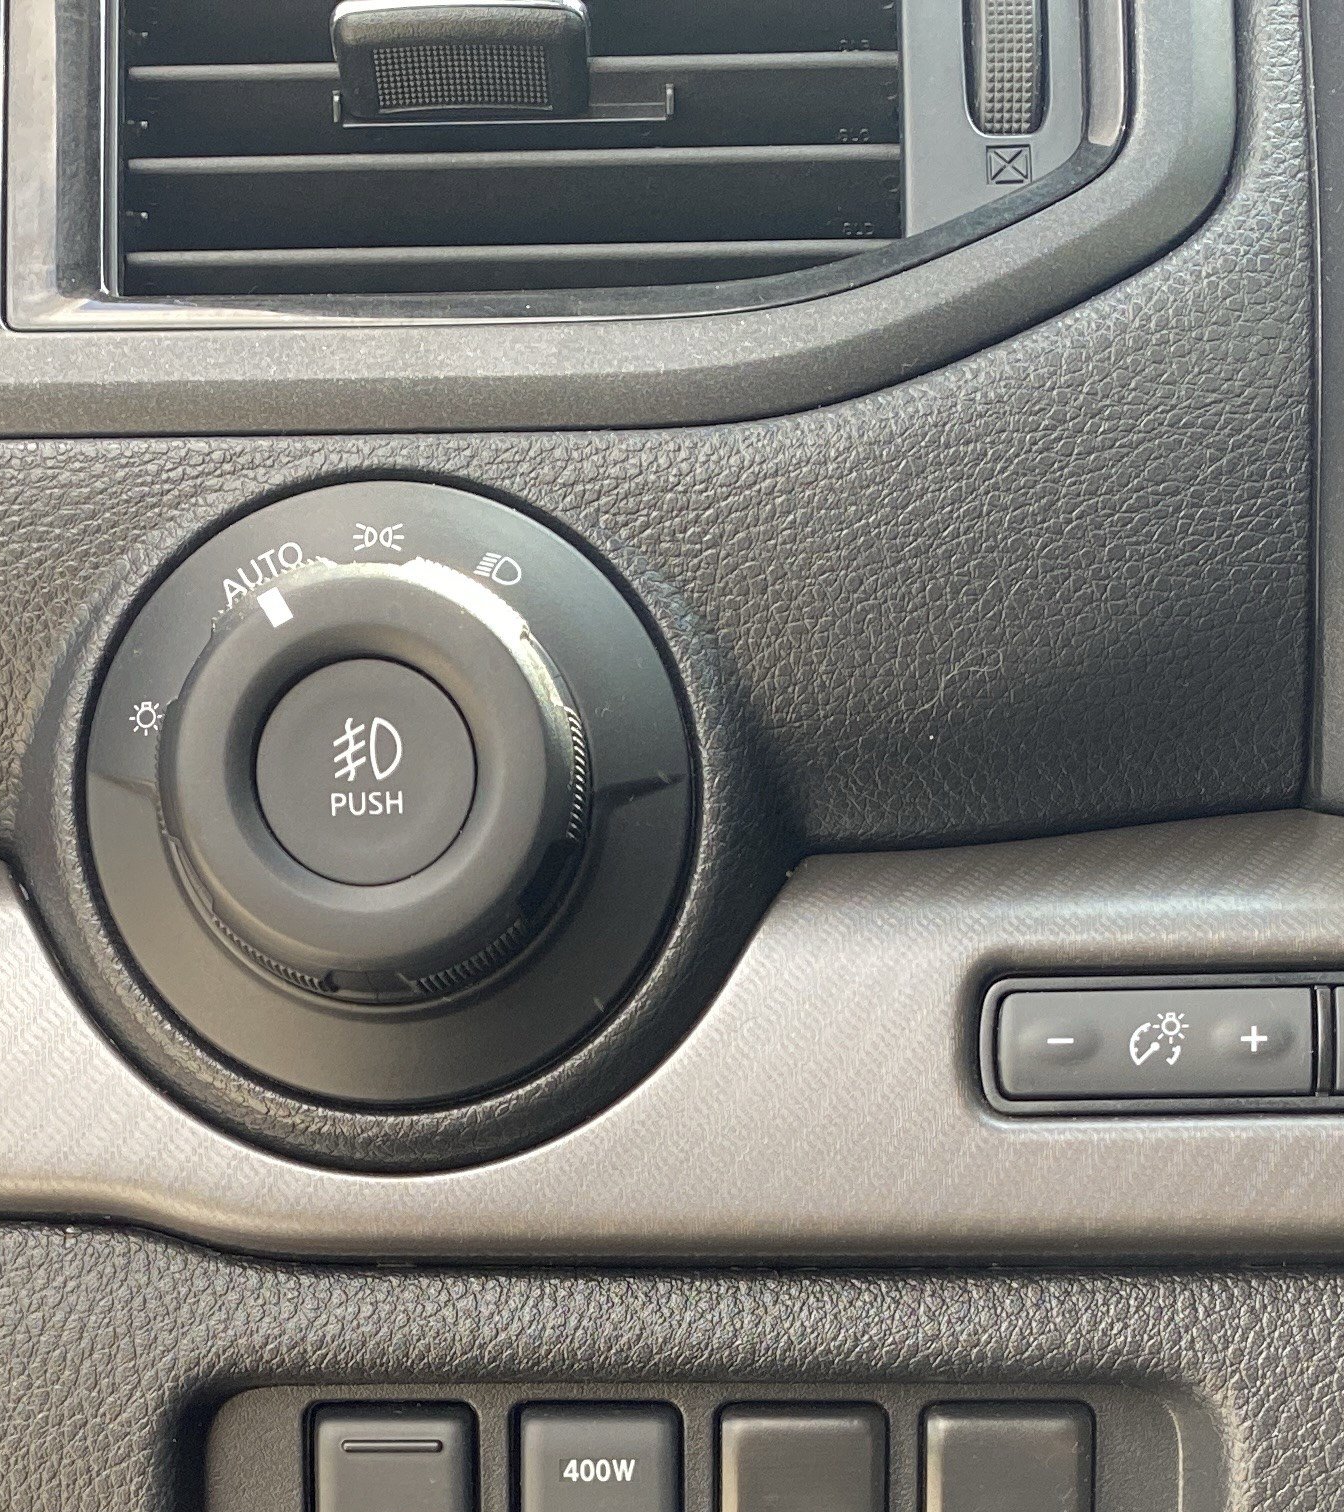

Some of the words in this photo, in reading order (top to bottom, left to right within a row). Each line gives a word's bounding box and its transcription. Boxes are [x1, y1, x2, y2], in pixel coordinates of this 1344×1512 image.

[221, 541, 304, 605] AUTO
[330, 790, 403, 817] PUSH
[562, 1458, 636, 1482] 400W
